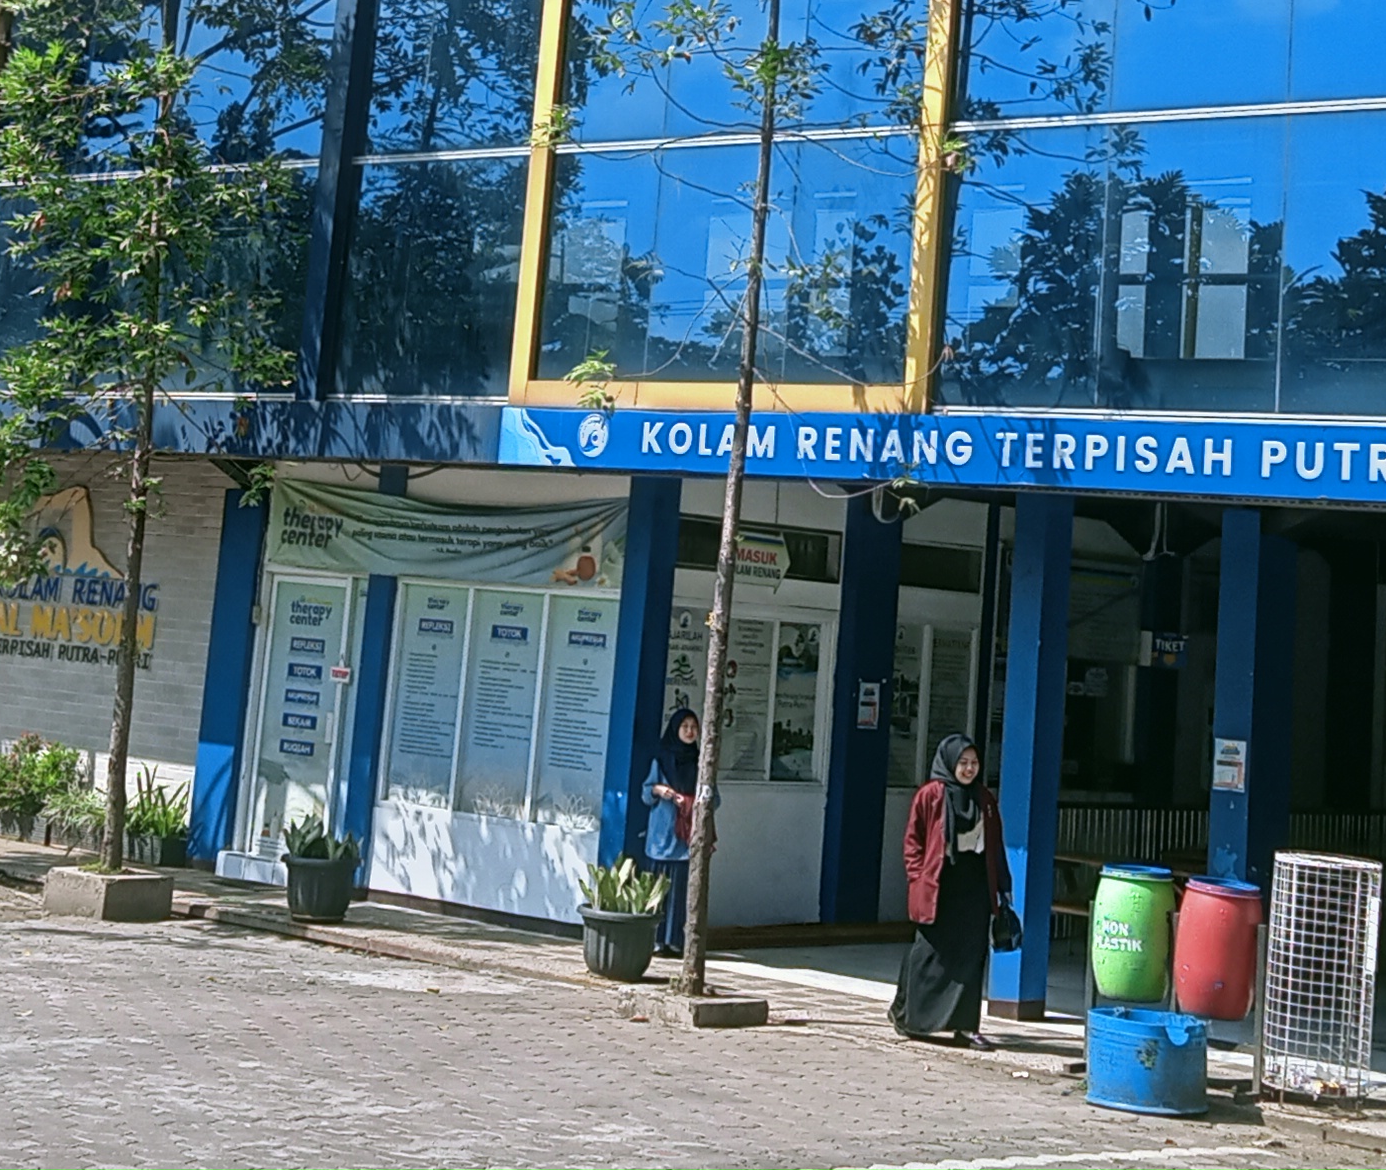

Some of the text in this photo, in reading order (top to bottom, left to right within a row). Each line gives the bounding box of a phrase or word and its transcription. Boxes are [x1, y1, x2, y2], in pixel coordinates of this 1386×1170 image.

[641, 421, 776, 459] KOLAM
[797, 424, 973, 466] RENANG
[996, 432, 1232, 478] TERPISAH
[283, 507, 343, 538] therapy
[281, 528, 333, 548] center
[736, 549, 778, 566] MASUK
[72, 577, 159, 612] RENAG
[291, 600, 332, 620] therapy
[290, 614, 324, 626] center
[497, 627, 522, 639] TOTOK
[1156, 638, 1185, 652] TIKET
[293, 665, 317, 677] TOTOK
